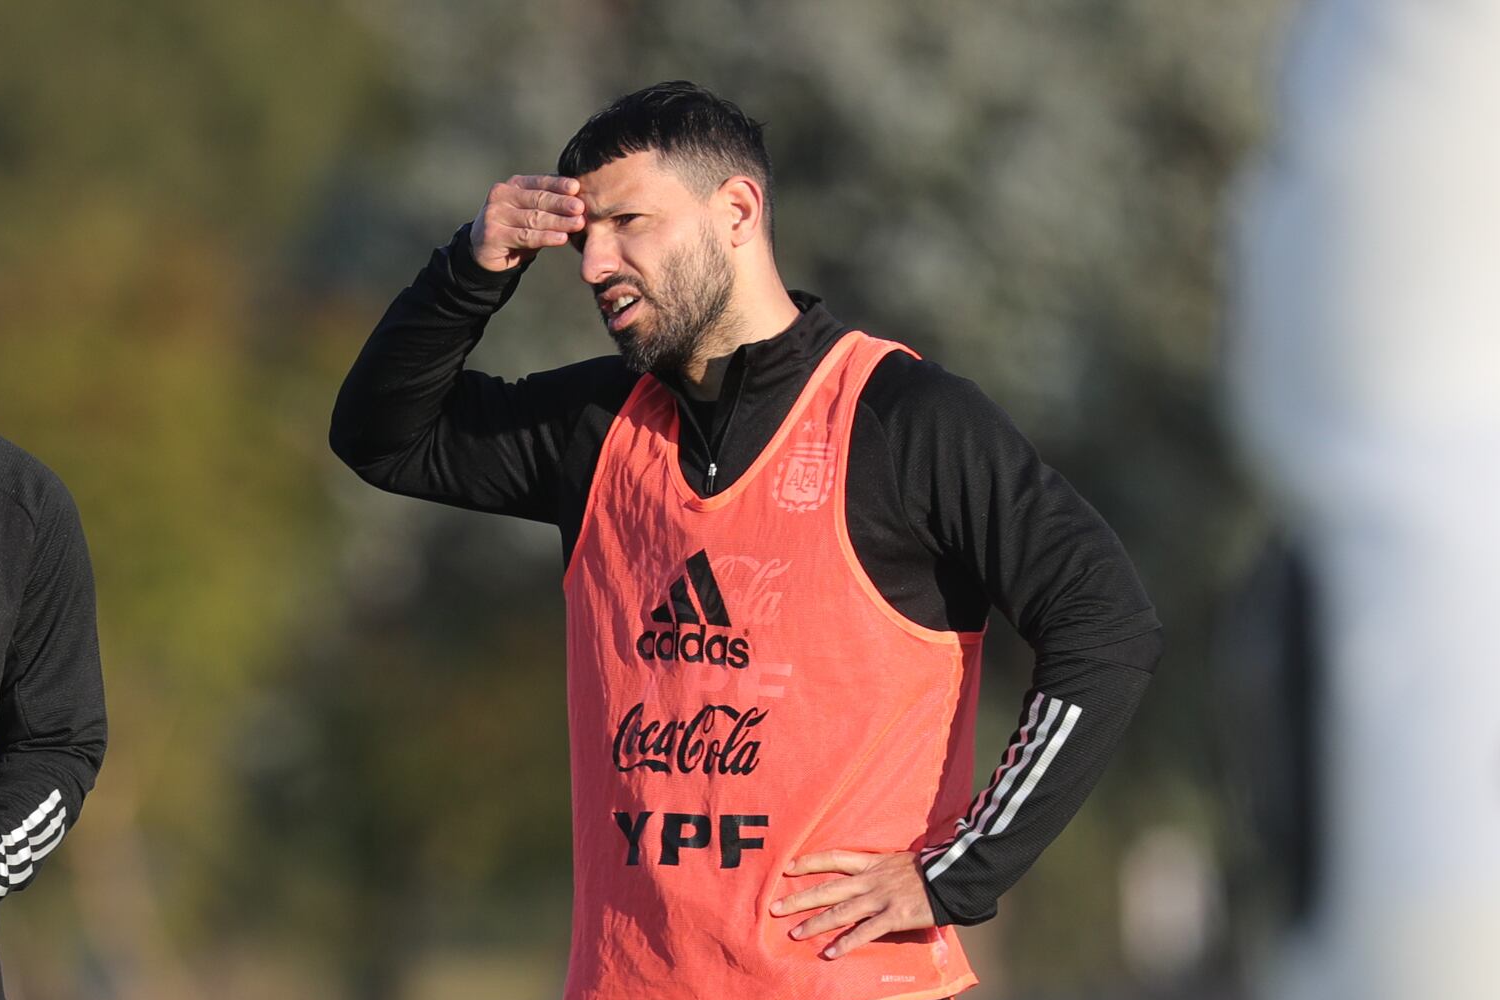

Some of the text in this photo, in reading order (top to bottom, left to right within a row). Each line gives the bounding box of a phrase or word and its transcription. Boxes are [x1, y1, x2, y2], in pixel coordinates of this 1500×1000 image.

[636, 622, 749, 670] adidas
[612, 702, 770, 776] Coca-Cola
[612, 811, 770, 870] YPF
